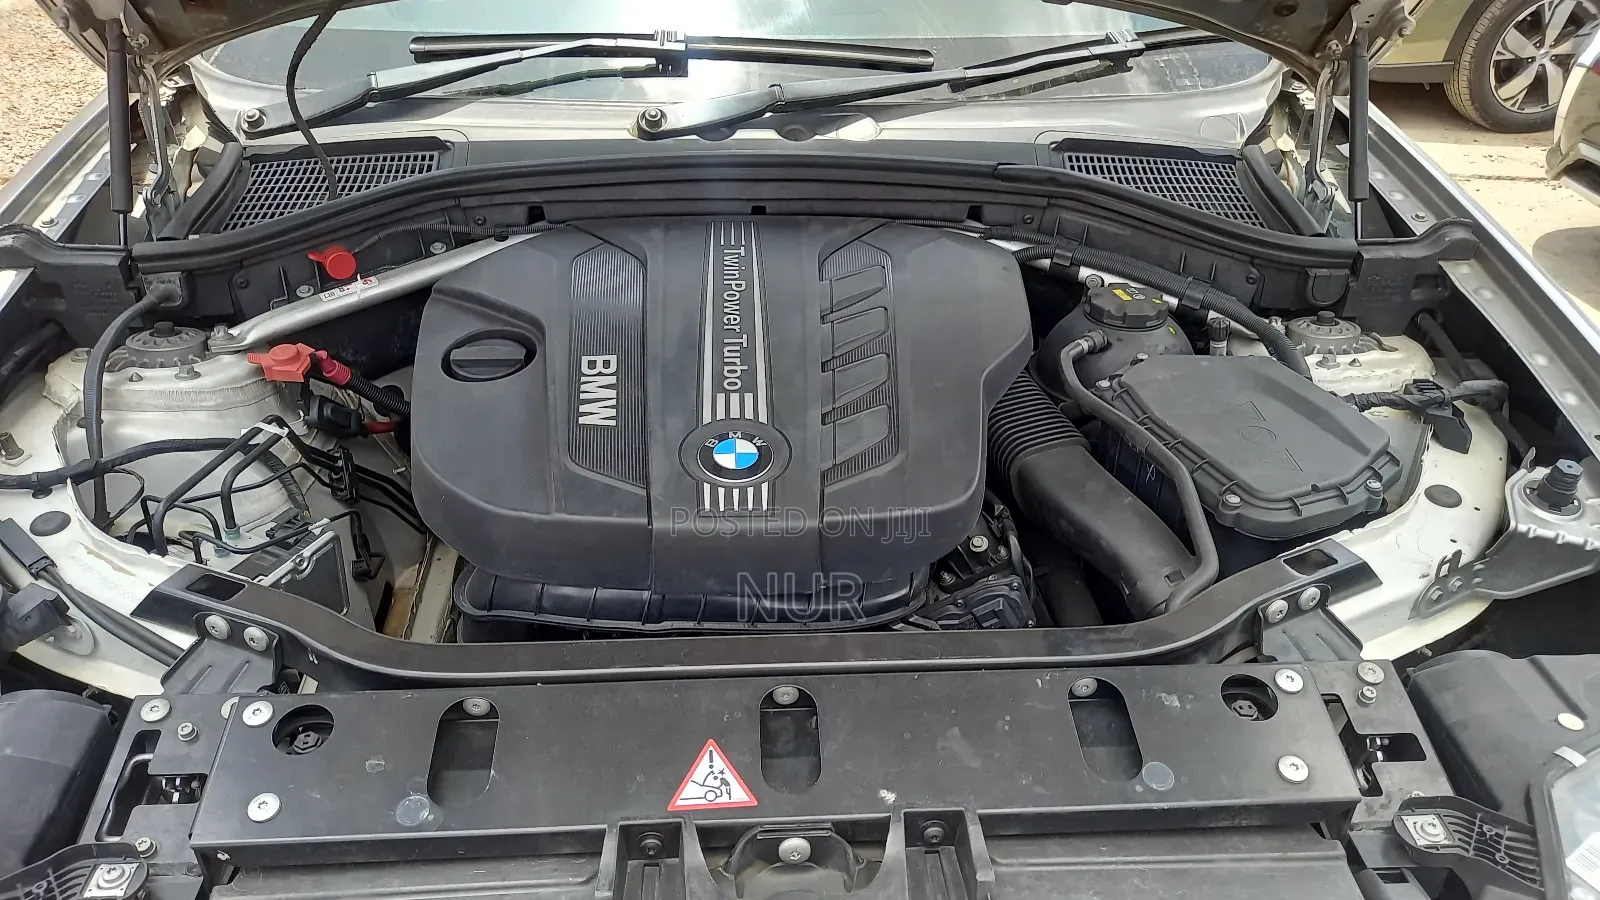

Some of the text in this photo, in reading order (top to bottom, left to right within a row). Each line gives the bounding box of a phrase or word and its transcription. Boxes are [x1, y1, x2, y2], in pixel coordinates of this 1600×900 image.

[723, 246, 749, 391] TwinPower Turbo
[578, 354, 618, 426] BMW
[704, 431, 768, 448] BMW
